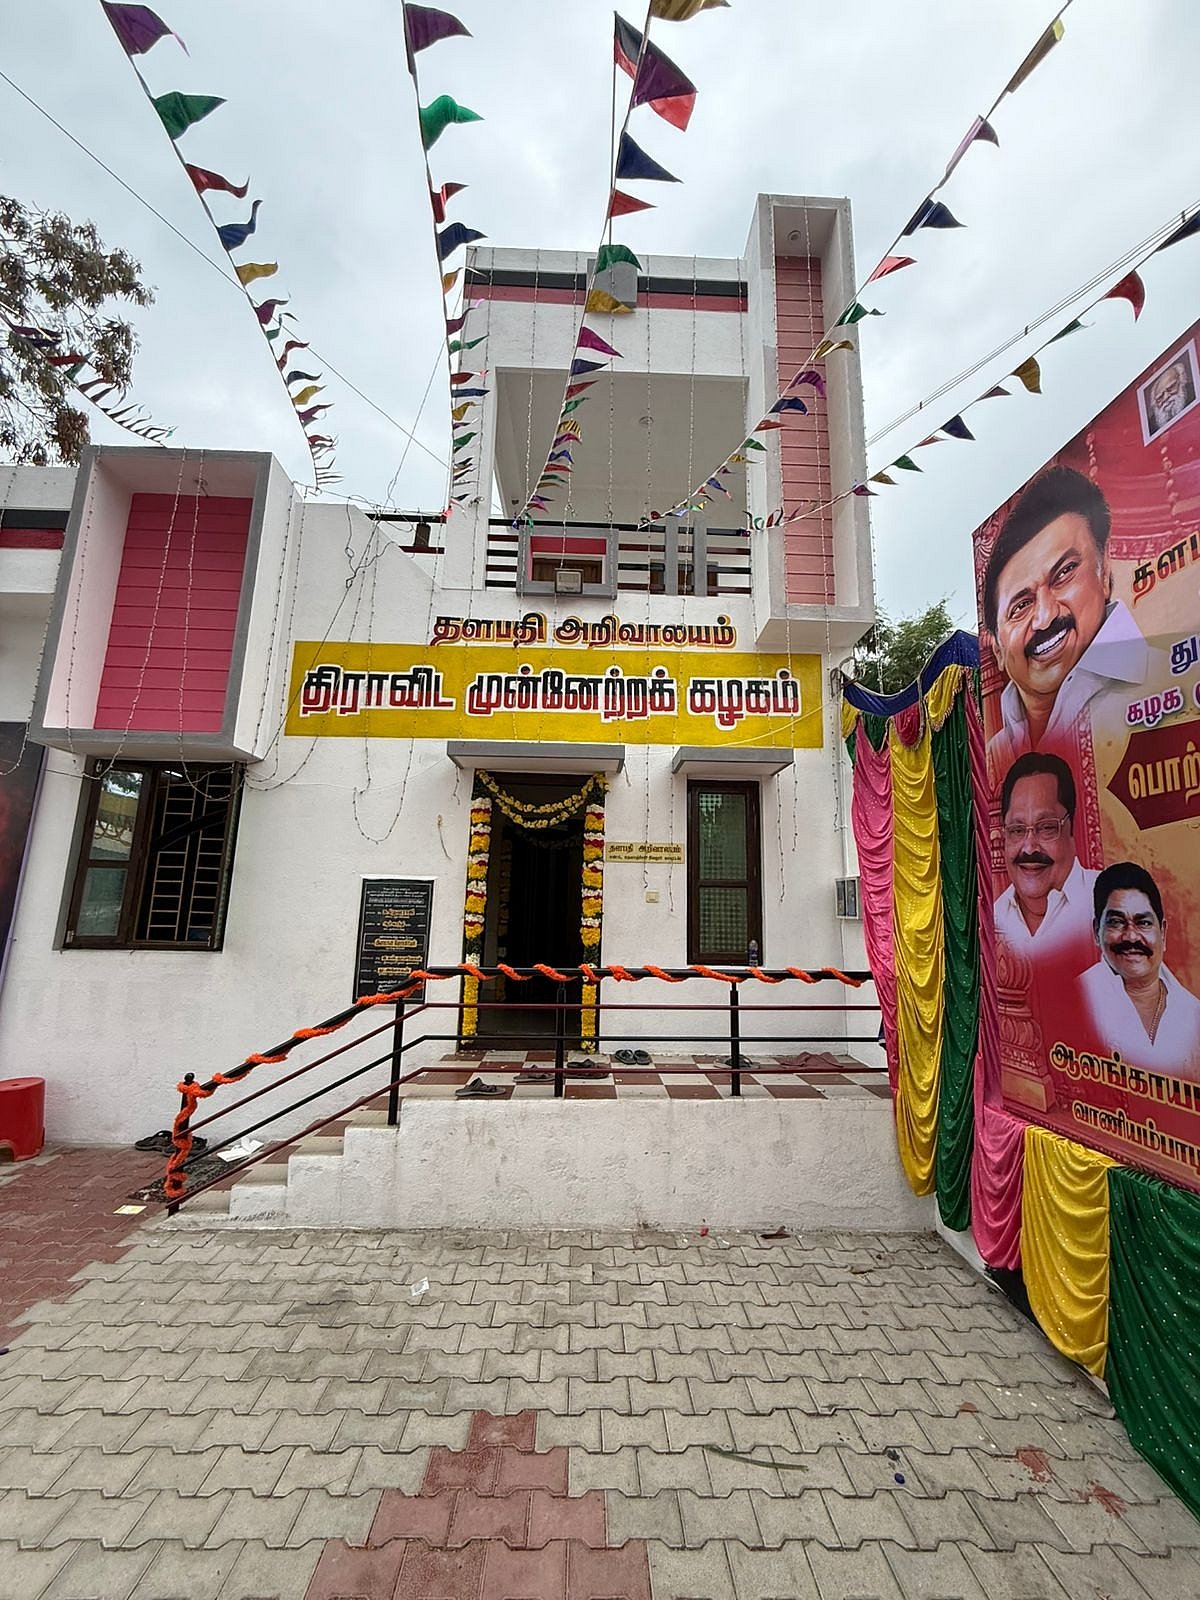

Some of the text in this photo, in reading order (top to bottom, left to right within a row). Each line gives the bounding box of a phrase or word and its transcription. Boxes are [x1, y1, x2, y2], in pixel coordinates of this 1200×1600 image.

[431, 612, 737, 649] தளபதி அறிவாலயம்
[1170, 635, 1200, 676] து
[301, 665, 801, 729] திராவிட முன்னேற்றக் கழகம்
[1126, 686, 1183, 726] கழக
[1051, 1042, 1200, 1114] ஆலங்காய
